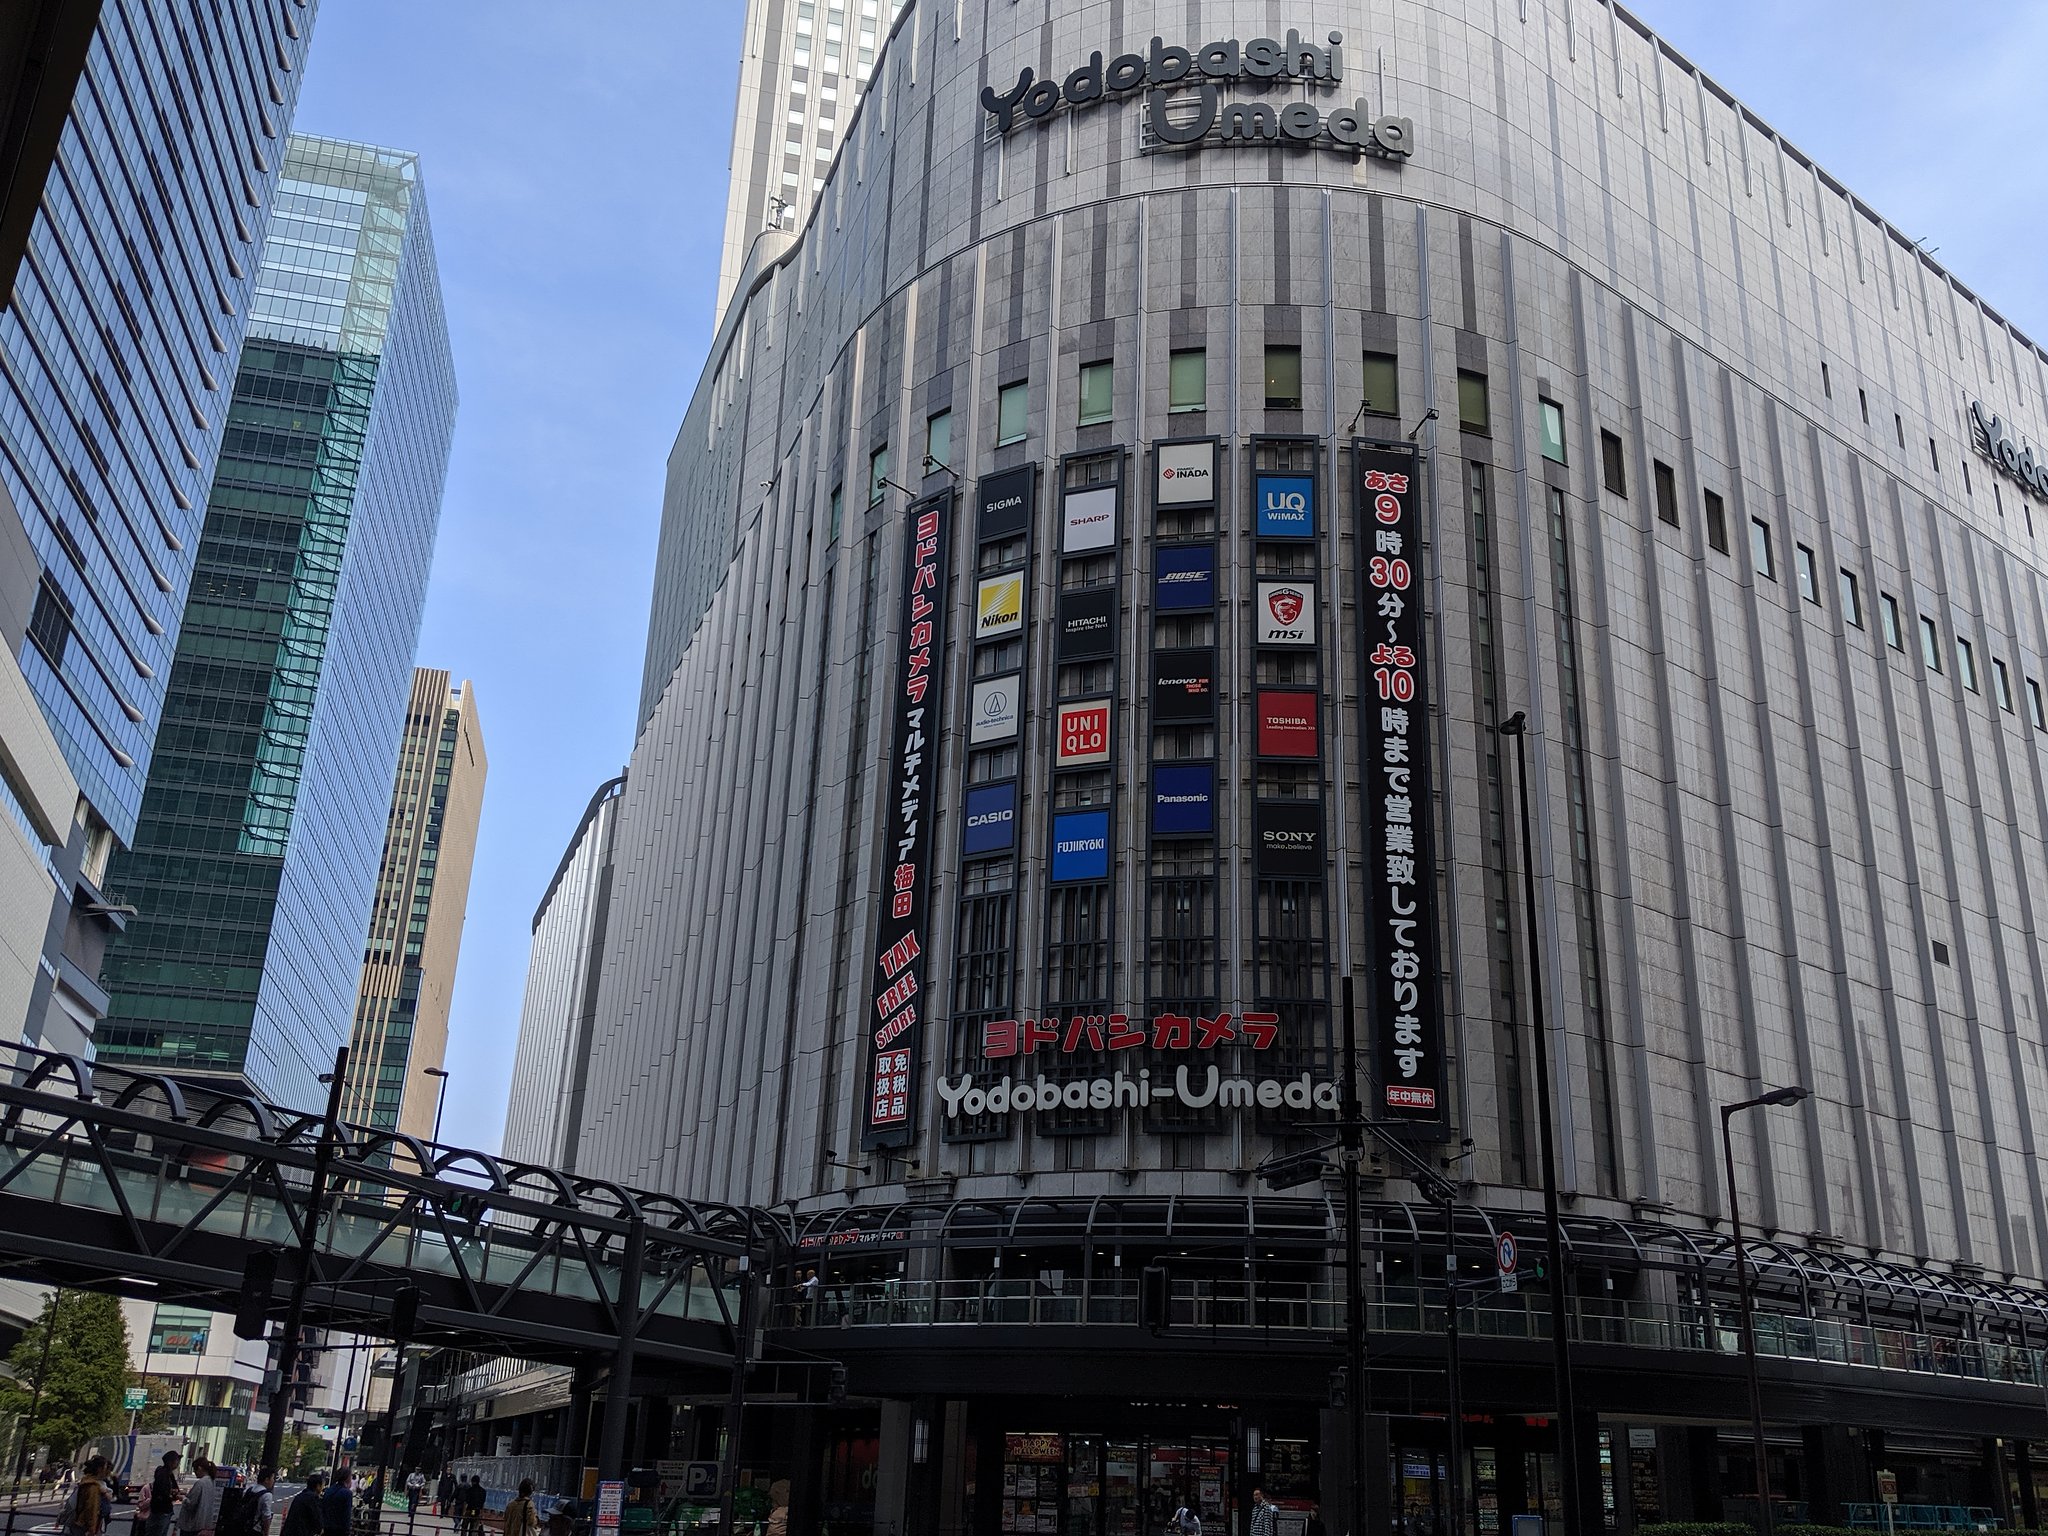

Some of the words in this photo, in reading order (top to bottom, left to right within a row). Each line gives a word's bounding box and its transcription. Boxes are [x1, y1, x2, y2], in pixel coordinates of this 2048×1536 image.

[980, 28, 1343, 133] Yodobashi
[1150, 85, 1414, 157] Umeda
[1176, 469, 1209, 478] INADA
[986, 496, 1022, 513] SIGMA
[1267, 493, 1306, 513] UQ
[1070, 514, 1110, 526] SHARP
[1267, 512, 1305, 521] WiMAX
[1164, 571, 1211, 580] BOSE
[907, 510, 939, 704] ヨドバシカメラ
[981, 611, 1019, 629] Nikon
[1068, 616, 1106, 628] HITACHI
[1268, 630, 1304, 640] msi
[1158, 678, 1197, 686] lenovo
[1066, 714, 1099, 733] UNI
[1266, 717, 1307, 725] TOSHIBA
[1066, 732, 1101, 753] QLO
[898, 708, 925, 861] マルチメディア
[1157, 793, 1208, 803] Panasonic
[967, 809, 1013, 827] CASIO
[1263, 831, 1317, 842] SONY
[892, 863, 915, 919] 梅田
[880, 929, 921, 980] TAX
[877, 970, 918, 1020] FREE
[875, 1004, 917, 1050] STORE
[984, 1012, 1279, 1059] ヨドバシカメラ
[891, 1053, 908, 1116] 免税品
[936, 1064, 1341, 1118] Yodobashi-Umeda
[1389, 1090, 1433, 1105] 年中無休
